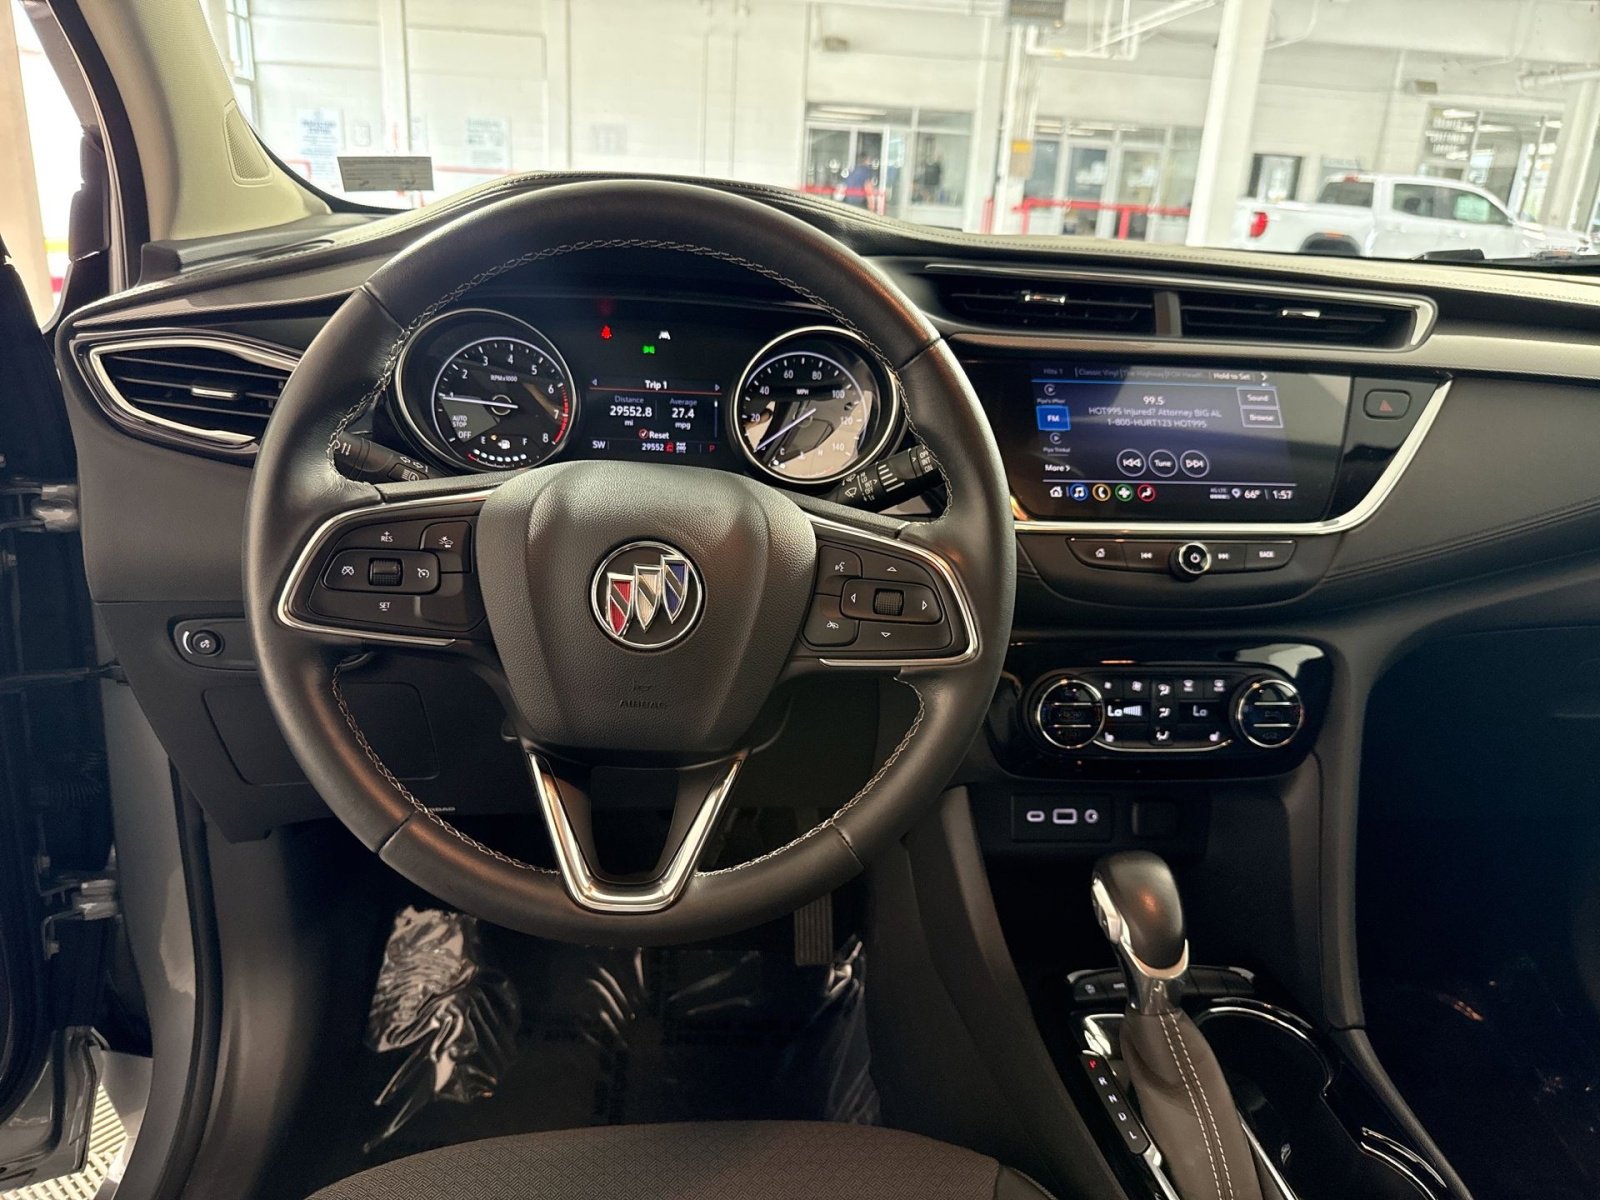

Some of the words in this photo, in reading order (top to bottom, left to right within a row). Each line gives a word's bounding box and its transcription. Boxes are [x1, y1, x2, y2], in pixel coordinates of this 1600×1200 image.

[483, 356, 489, 366] 3
[508, 354, 514, 364] 4
[462, 369, 468, 379] 2
[531, 365, 538, 375] 5
[784, 370, 794, 379] 60
[812, 370, 822, 380] 80
[548, 384, 554, 394] 6
[644, 380, 661, 390] Trip
[662, 380, 668, 390] 1
[760, 386, 770, 395] 40
[832, 390, 845, 399] 100
[614, 395, 644, 404] Distance
[670, 398, 698, 406] Average
[1143, 396, 1165, 406] 99.5
[554, 410, 559, 420] 7
[610, 405, 652, 417] 29552.8
[672, 408, 694, 418] 27.4
[1158, 409, 1193, 418] Attorney
[1194, 410, 1210, 418] BIG
[750, 413, 760, 422] 20
[675, 422, 691, 430] mpg
[542, 433, 548, 442] 8
[649, 431, 670, 439] Reset
[480, 436, 486, 444] E
[522, 438, 528, 446] F
[592, 440, 606, 448] SW
[642, 443, 664, 452] 29552
[1154, 460, 1172, 468] Tune
[1272, 490, 1292, 500] 1:57
